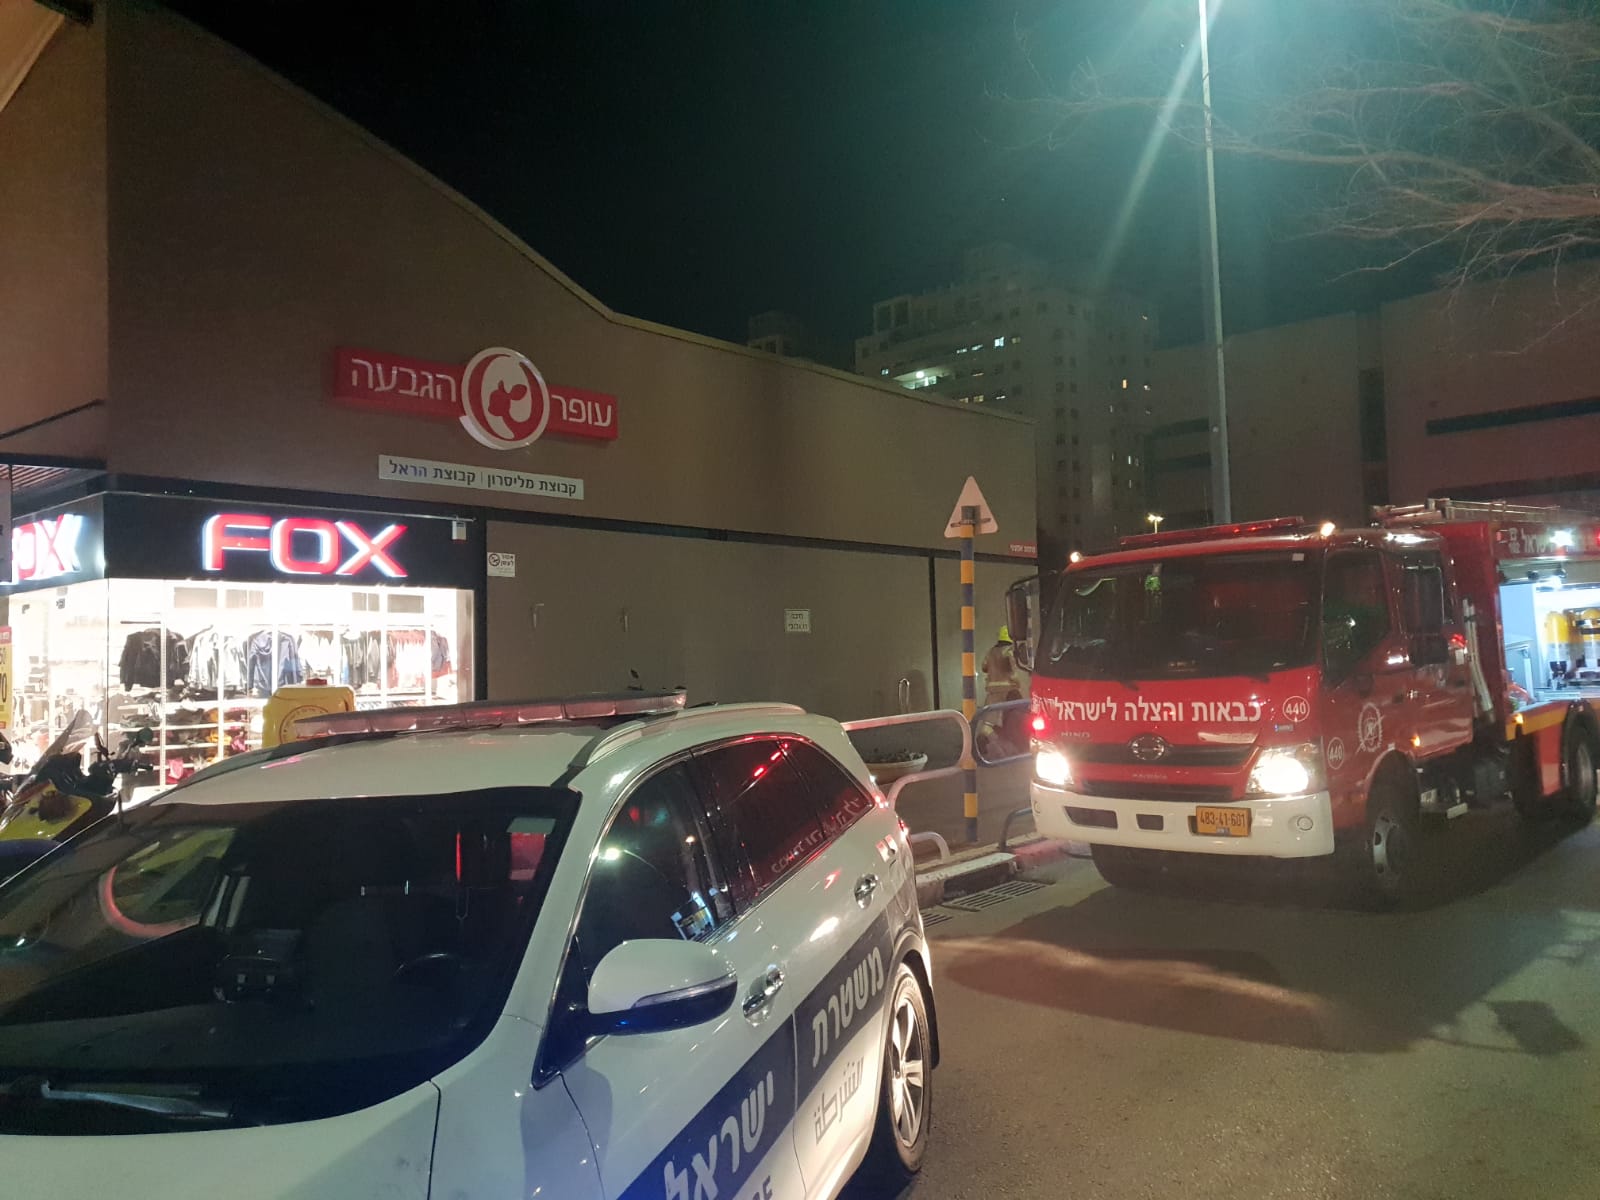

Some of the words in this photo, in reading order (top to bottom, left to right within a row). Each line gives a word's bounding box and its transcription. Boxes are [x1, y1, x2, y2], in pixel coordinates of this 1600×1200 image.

[351, 358, 457, 402] הגבעה
[551, 394, 612, 427] עופר
[389, 460, 427, 477] הראל
[432, 467, 476, 485] קבוצת
[487, 474, 534, 490] מליסרון
[539, 480, 576, 497] קבוצת
[11, 513, 83, 580] OX
[203, 513, 408, 577] FOX
[1055, 696, 1117, 721] לישראל
[1124, 696, 1184, 721] והצלה
[1191, 701, 1262, 721] כבאות
[1285, 702, 1307, 715] 440
[1061, 731, 1091, 739] HINO
[1328, 745, 1343, 761] 440
[812, 947, 884, 1068] משטרת
[814, 1056, 864, 1144] الشرطة
[664, 1070, 774, 1200] ישראל
